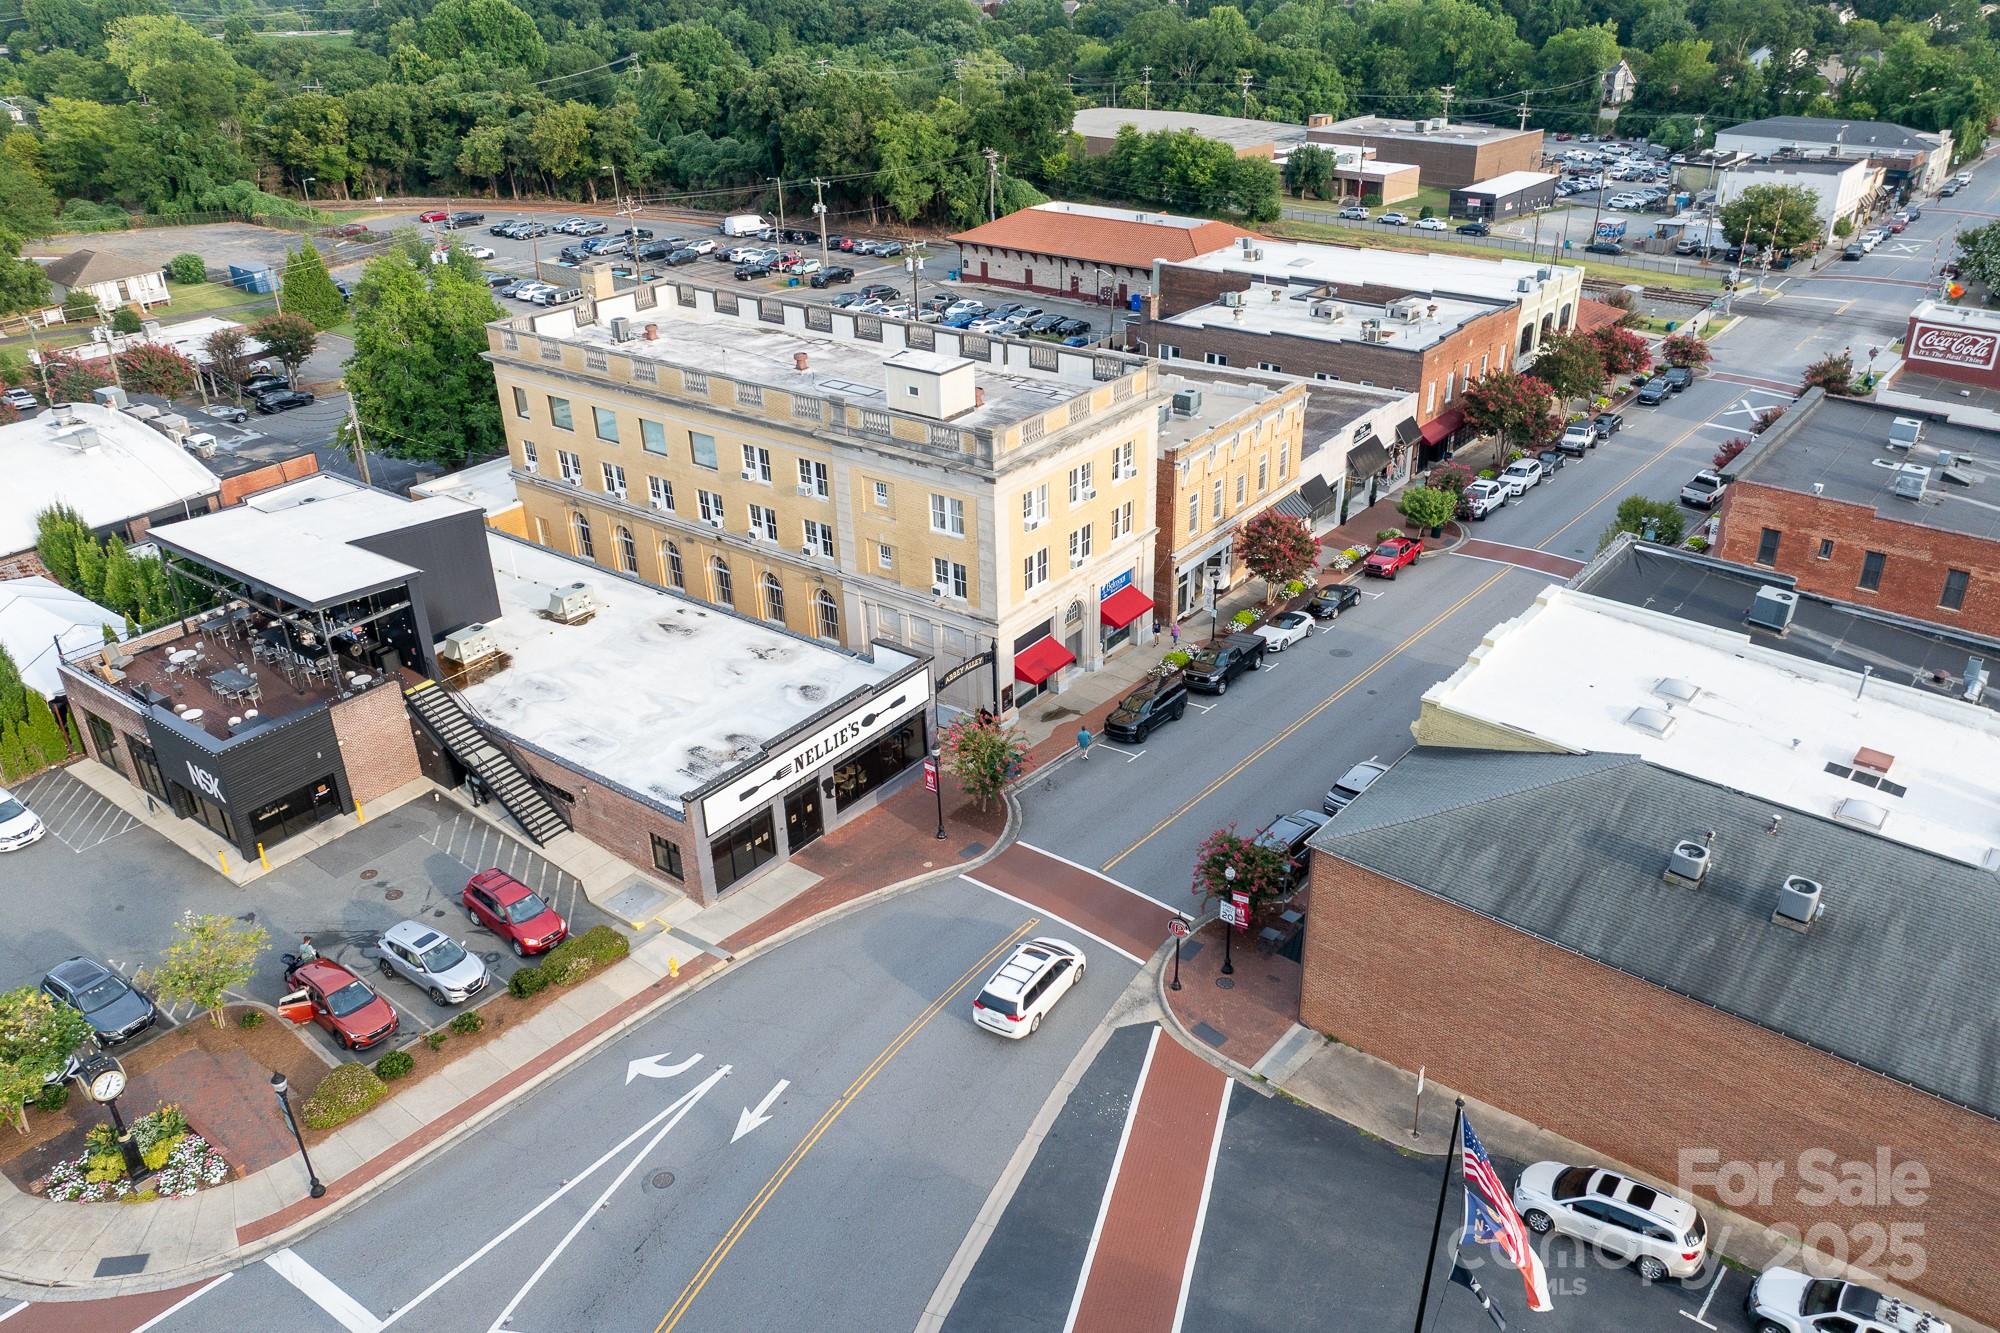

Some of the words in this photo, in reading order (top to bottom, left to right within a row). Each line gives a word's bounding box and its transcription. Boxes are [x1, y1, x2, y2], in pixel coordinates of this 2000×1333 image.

[1918, 330, 1995, 357] Coca-Cola
[945, 666, 964, 684] ABBEY
[965, 656, 983, 672] ALLEY
[793, 721, 860, 773] NELLIE'S
[185, 760, 227, 804] NSK
[1222, 911, 1233, 921] 20
